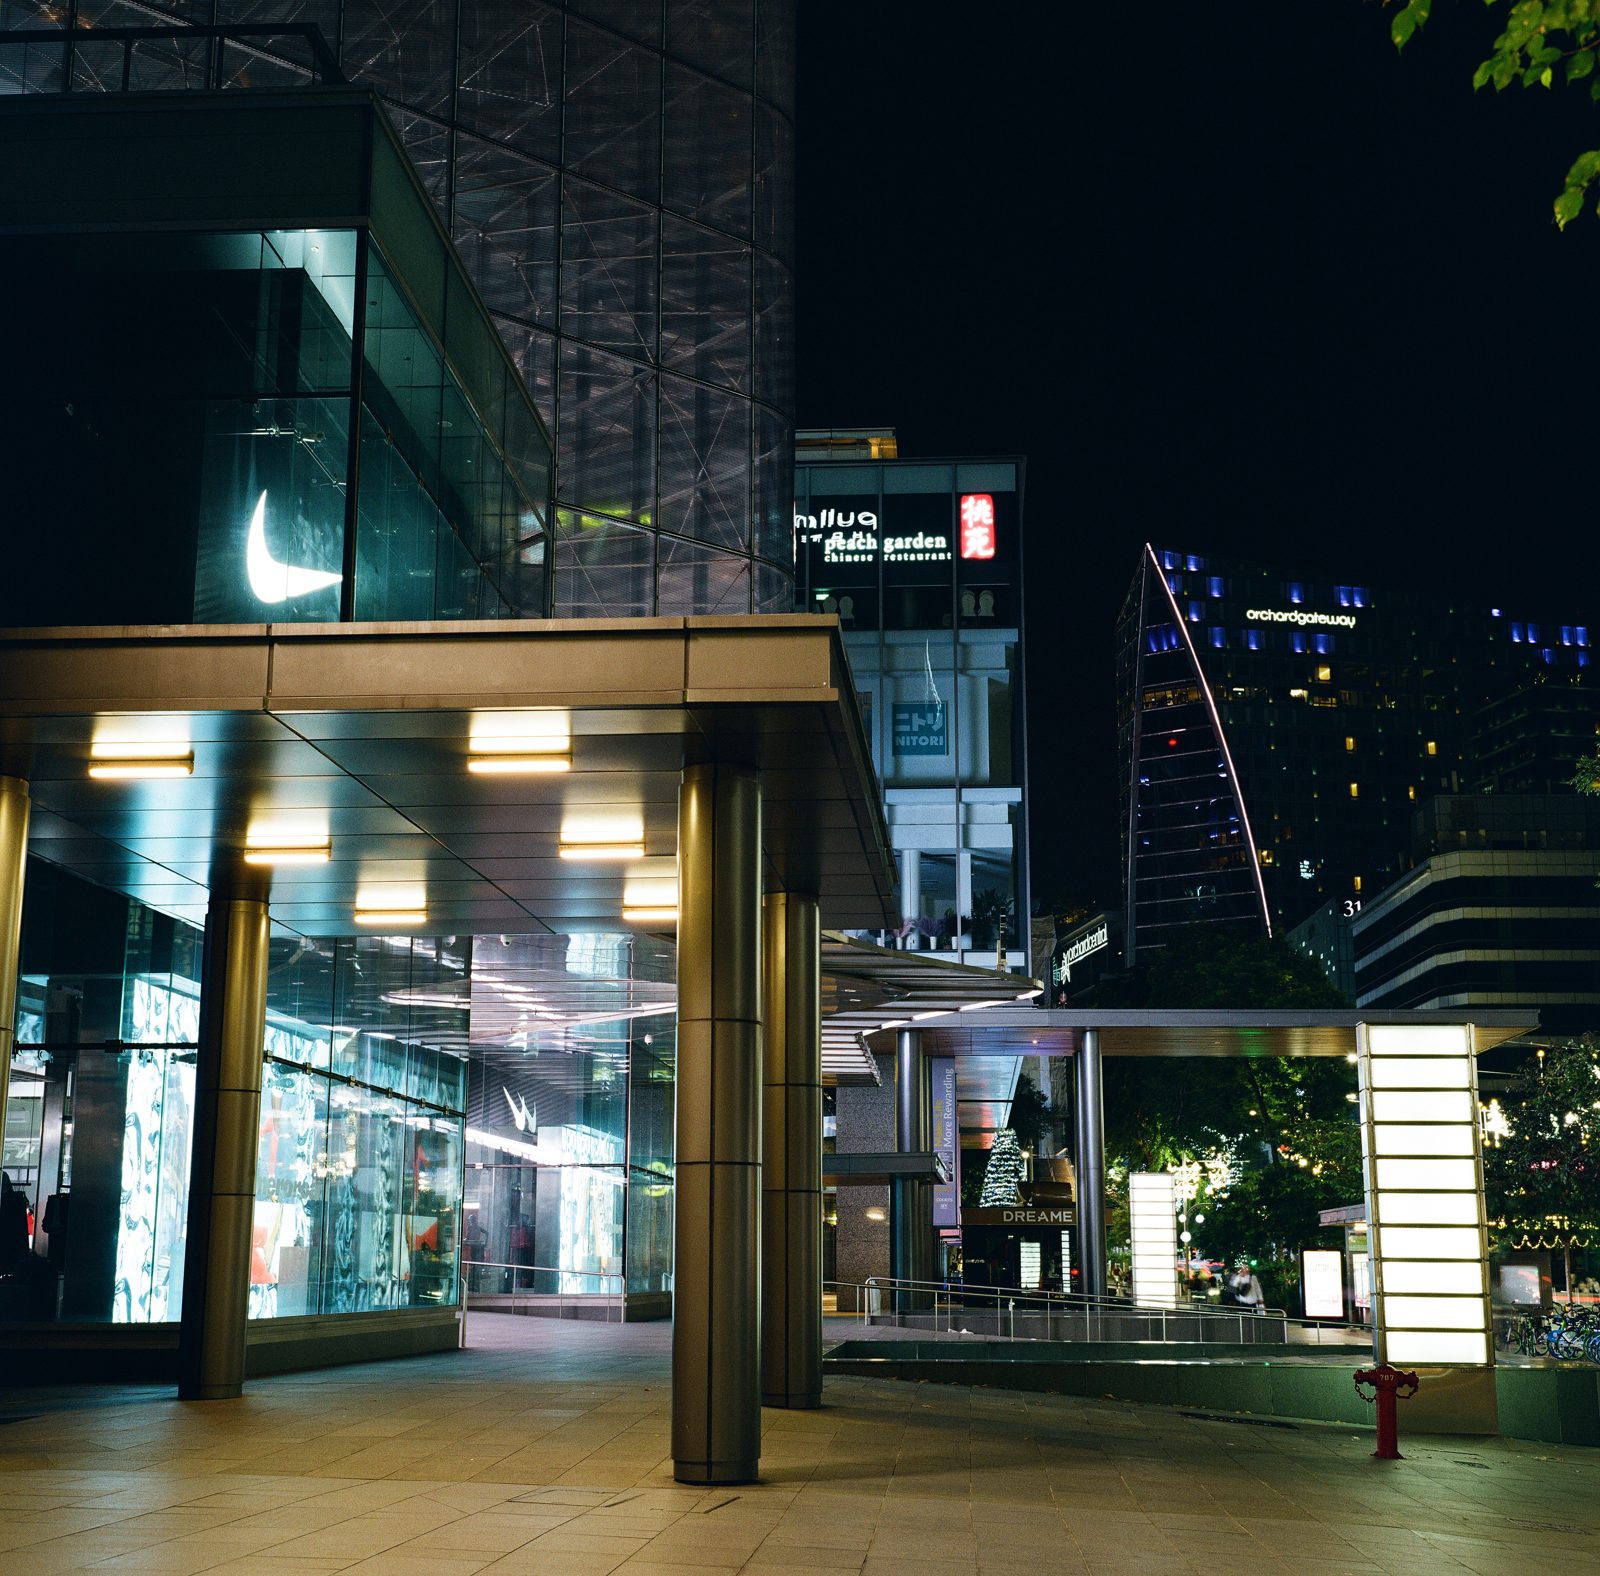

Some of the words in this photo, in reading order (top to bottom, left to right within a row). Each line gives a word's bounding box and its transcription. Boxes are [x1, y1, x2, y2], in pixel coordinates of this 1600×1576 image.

[824, 532, 877, 554] peach
[883, 532, 947, 554] garden
[824, 552, 873, 562] chinese
[883, 551, 952, 562] restaurant
[1246, 609, 1356, 629] orchardgateway
[895, 713, 943, 732] ニトリ
[895, 735, 944, 746] NITORI
[943, 1068, 954, 1119] Rewarding
[943, 1121, 952, 1148] More
[1003, 1211, 1073, 1222] DREAME
